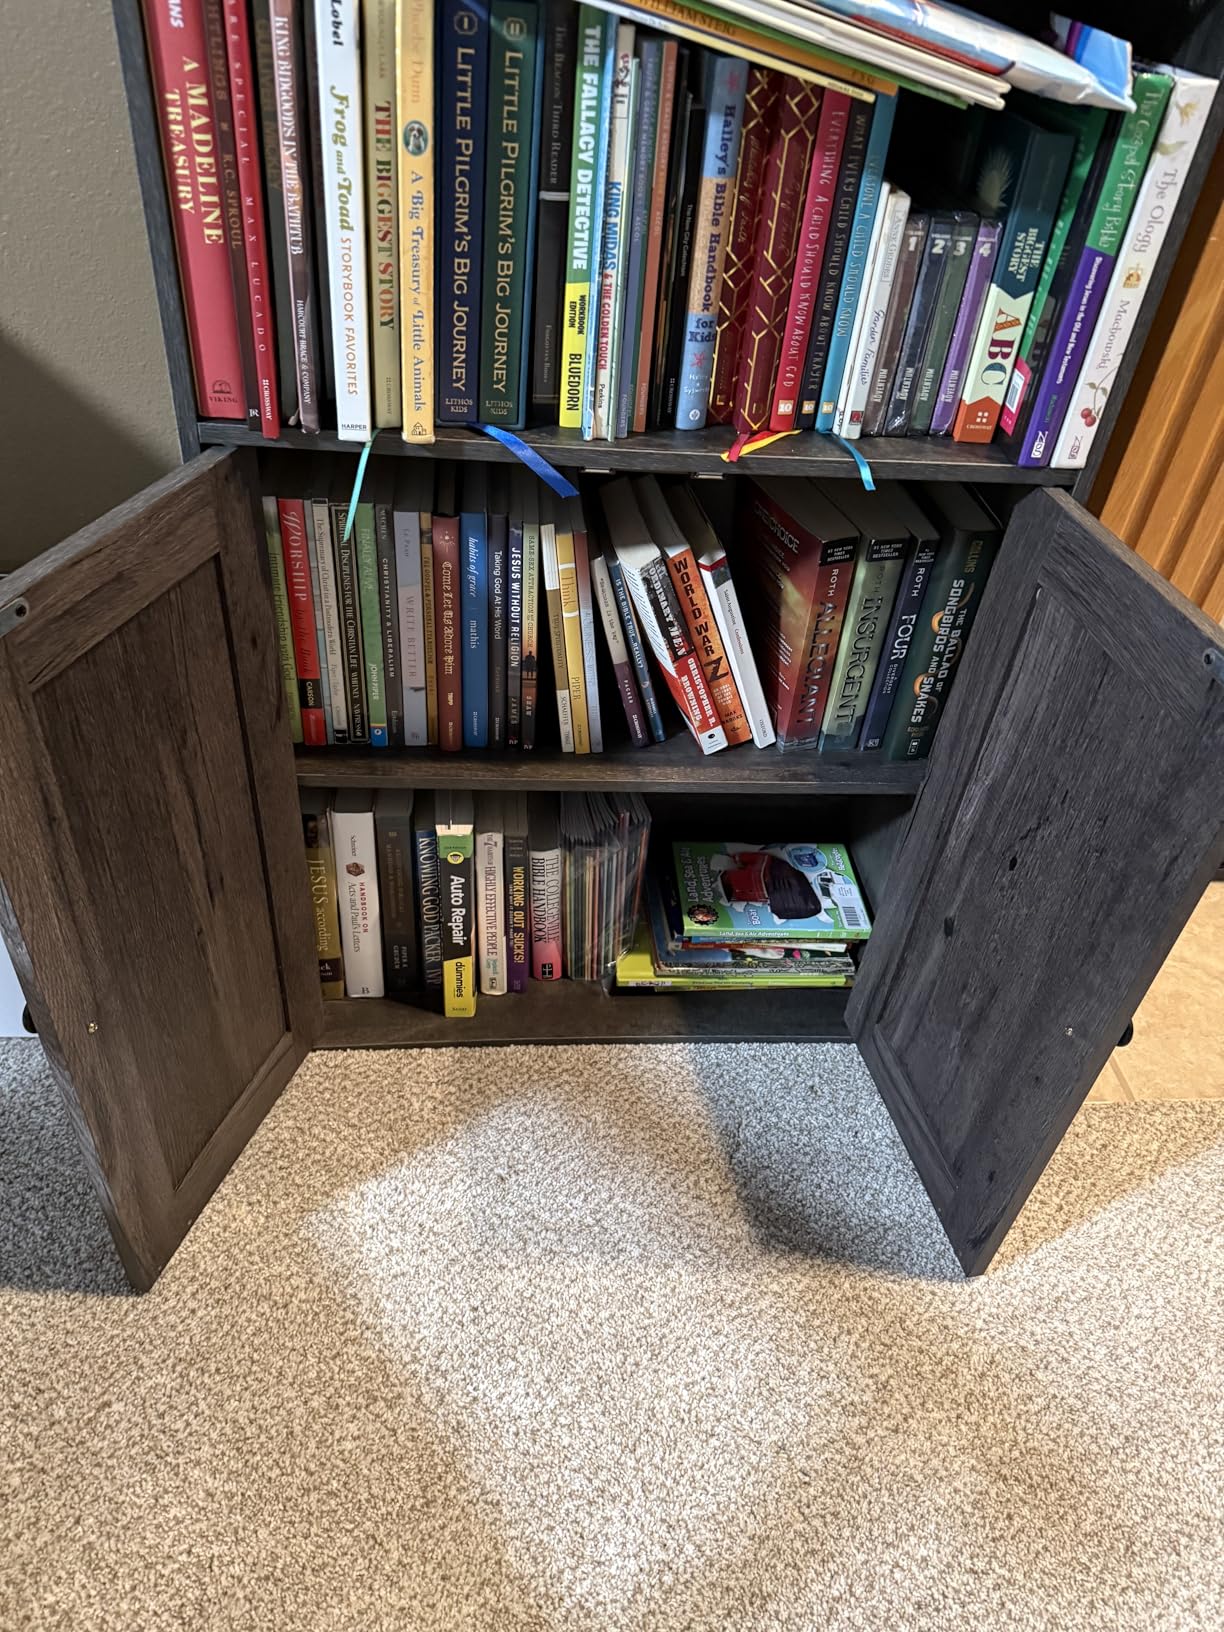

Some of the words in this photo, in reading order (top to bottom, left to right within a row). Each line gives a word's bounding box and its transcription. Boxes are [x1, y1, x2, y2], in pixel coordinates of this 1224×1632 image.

[274, 16, 290, 56] KING
[583, 25, 601, 67] THE
[182, 56, 200, 73] A
[455, 47, 476, 131] LITTLE
[502, 51, 523, 133] LITTLE
[1144, 88, 1166, 117] The
[234, 62, 250, 164] SPECIAL
[329, 85, 350, 147] Frog
[374, 101, 392, 152] THE
[578, 73, 599, 164] FALLACY
[165, 88, 195, 215] TREASURY
[283, 140, 298, 157] IN
[715, 104, 737, 175] Halley's
[1122, 118, 1151, 166] Gospel
[185, 81, 225, 245] MADELINE
[222, 153, 236, 184] R.C.
[284, 158, 301, 190] THE
[336, 151, 346, 174] and
[411, 171, 424, 184] A
[454, 138, 474, 252] PILGRIM'S
[499, 142, 519, 254] PILGRIM'S
[607, 181, 622, 219] KING
[1102, 168, 1137, 213] Story
[1155, 168, 1178, 196] The
[226, 189, 243, 249] SPROUL
[245, 197, 258, 243] MAX
[336, 176, 354, 232] Toad
[375, 158, 394, 257] BIGGEST
[409, 191, 424, 220] Big
[572, 169, 593, 270] DETECTIVE
[711, 182, 728, 227] Bible
[837, 197, 853, 229] CHILD
[287, 193, 304, 255] BATHTUB
[808, 206, 825, 240] CHILD
[1098, 215, 1122, 249] Bible
[1132, 204, 1165, 254] Ology
[408, 225, 424, 296] Treasury
[603, 221, 621, 271] MIDAS
[829, 234, 847, 276] SHOULD
[851, 226, 868, 258] CHILD
[908, 236, 918, 252] 1
[931, 239, 945, 254] 2
[952, 241, 967, 257] 3
[978, 242, 992, 258] 4
[1007, 232, 1027, 274] STORY
[1015, 228, 1039, 283] BIGGEST
[1030, 241, 1045, 268] THE
[340, 238, 354, 321] STORYBOOK
[453, 258, 471, 295] BIG
[497, 259, 514, 296] BIG
[702, 233, 721, 313] Handbook
[800, 243, 820, 289] SHOULD
[842, 261, 862, 304] SHOULD
[250, 261, 267, 352] LUCADO
[377, 262, 395, 331] STORY
[602, 281, 613, 300] THE
[797, 293, 811, 323] KNOW
[822, 282, 836, 313] KNOW
[411, 309, 425, 351] Little
[568, 301, 577, 328] EDITION
[577, 295, 586, 335] WORKBOOK
[601, 301, 611, 337] GOLDEN
[694, 318, 715, 330] for
[815, 316, 830, 347] ABOUT
[836, 304, 854, 338] KNOW
[296, 299, 307, 338] HARCOURT
[302, 371, 311, 404] COMPANY
[452, 301, 470, 392] JOURNEY
[492, 303, 512, 393] JOURNEY
[598, 337, 610, 370] TOUCH
[790, 323, 806, 361] ABOUT
[980, 308, 1023, 386] ABC
[344, 327, 358, 396] FAVORITES
[783, 364, 799, 388] GOD
[412, 356, 428, 412] Animals
[566, 353, 582, 412] BLUEDORN
[873, 368, 889, 403] ADVENTUM
[900, 367, 915, 401] ADVENTUM
[919, 368, 935, 401] ADVENTUM
[944, 369, 960, 403] ADVENTUM
[445, 398, 473, 406] LITHOS
[281, 511, 308, 601] WORSHIP
[468, 536, 478, 566] habits
[493, 550, 503, 576] Taking
[511, 547, 521, 579] JESUS
[963, 539, 984, 574] COLLINS
[340, 549, 352, 592] DISCIPLINES
[382, 558, 391, 619] CHRISTIANITY
[442, 561, 453, 591] Come
[467, 565, 479, 575] of
[494, 577, 503, 594] God
[673, 556, 702, 621] WORLD
[828, 568, 839, 597] ROTH
[911, 567, 926, 597] ROTH
[406, 596, 416, 630] WRITE
[442, 592, 453, 609] Let
[494, 595, 502, 605] At
[494, 605, 502, 618] His
[511, 580, 521, 624] WITHOUT
[527, 573, 535, 616] ATTRACTION
[620, 599, 630, 619] BIBLE
[649, 567, 674, 624] ORDINARY
[667, 623, 688, 658] MEN
[494, 619, 502, 640] Word
[932, 578, 966, 653] SONGBIRDS
[955, 607, 968, 626] THE
[346, 619, 358, 655] CHRISTIAN
[443, 625, 455, 656] Adore
[470, 620, 480, 649] mathis
[510, 626, 520, 667] RELIGION
[695, 621, 716, 657] WAR
[890, 614, 917, 660] FOUR
[349, 655, 359, 668] LIFE
[386, 629, 395, 678] LIBERALISM
[408, 637, 416, 677] BETTER
[703, 656, 730, 683] Z
[837, 596, 884, 723] INSURGENT
[927, 654, 940, 674] AND
[937, 628, 962, 679] BALLAD
[306, 681, 315, 706] CARSON
[351, 672, 360, 699] WHITNEY
[572, 676, 581, 700] PIPER
[681, 674, 703, 721] BROWNING
[687, 657, 710, 717] CHRISTOPHER
[910, 675, 935, 724] SNAKES
[307, 859, 328, 904] JESUS
[419, 837, 440, 895] KNOWING
[485, 866, 497, 892] HIGHLY
[531, 857, 545, 886] BIBLE
[546, 854, 560, 878] THE
[697, 856, 715, 903] Adventures
[348, 881, 358, 897] Acts
[359, 881, 368, 921] HANDBOOK
[450, 875, 465, 905] Auto
[512, 866, 525, 907] WORKING
[351, 911, 361, 930] Paul's
[362, 923, 369, 933] ON
[421, 896, 440, 923] GOD
[447, 908, 467, 946] Repair
[485, 893, 497, 932] EFFECTIVE
[513, 910, 525, 928] OUT
[533, 888, 547, 943] HANDBOOK
[546, 879, 561, 943] COLLEGEVILLE
[352, 930, 361, 953] Letters
[423, 925, 441, 965] PACKER
[486, 932, 498, 957] PEOPLE
[513, 932, 525, 964] SUCKS!
[455, 961, 466, 998] dummies
